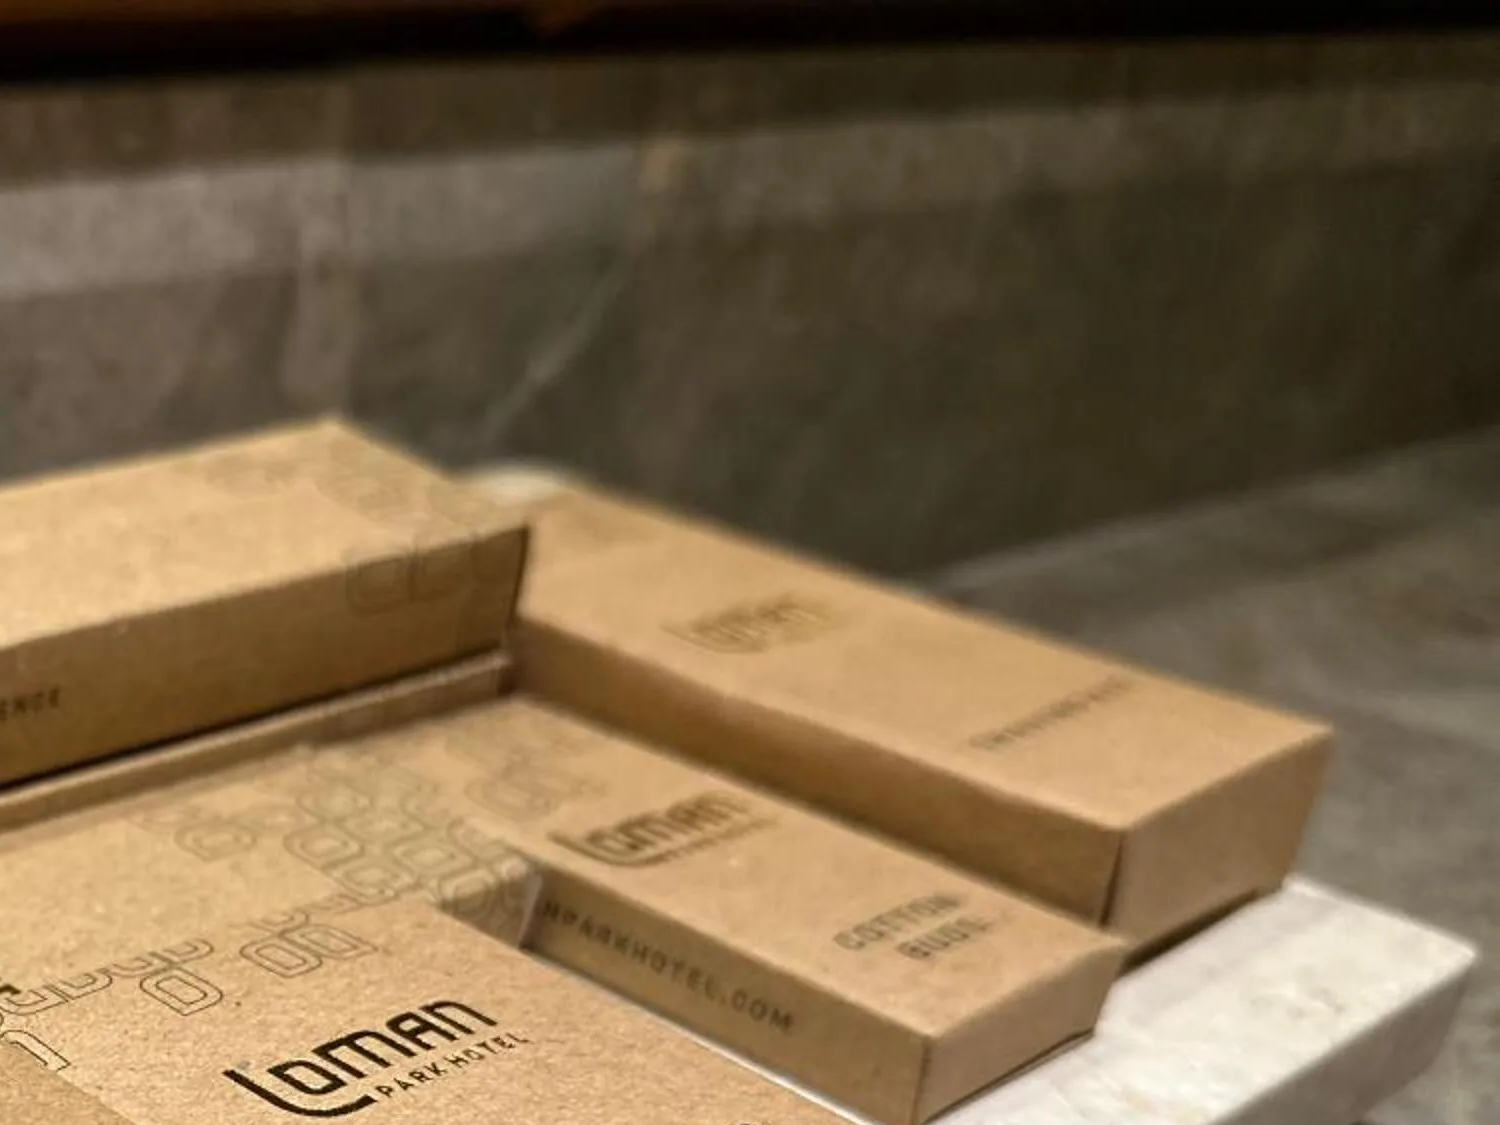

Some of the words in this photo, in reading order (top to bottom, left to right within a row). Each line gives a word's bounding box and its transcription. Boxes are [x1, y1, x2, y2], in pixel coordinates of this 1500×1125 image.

[222, 999, 499, 1118] LOMAN
[375, 1061, 448, 1098] PARK
[443, 1032, 531, 1069] HOTEL
